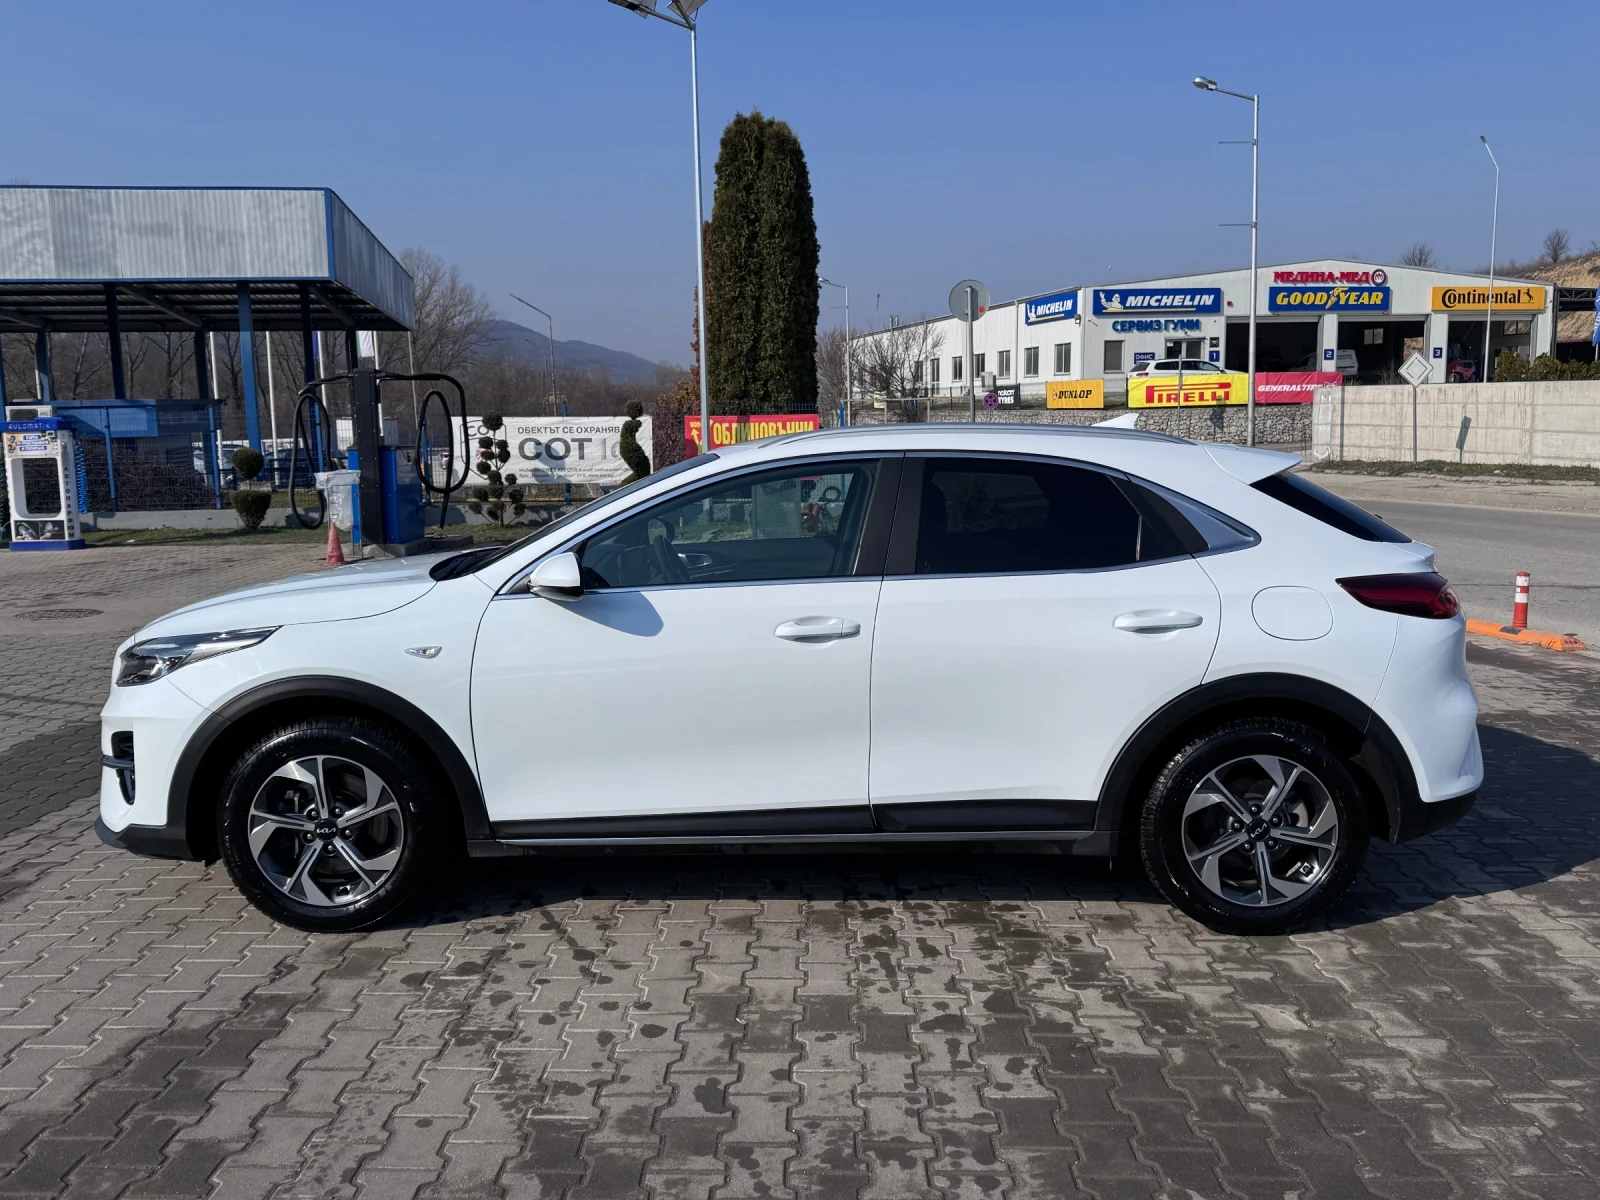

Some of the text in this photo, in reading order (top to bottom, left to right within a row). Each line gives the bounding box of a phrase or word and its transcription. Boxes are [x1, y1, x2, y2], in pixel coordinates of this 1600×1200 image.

[1125, 294, 1216, 306] MICHELIN
[1441, 288, 1521, 308] Continental
[1036, 299, 1073, 317] MICHELIN
[1112, 319, 1200, 332] СЕРВИЗ ГУМИ
[1434, 349, 1441, 357] 3
[1058, 389, 1092, 400] DUNLOP
[1145, 382, 1231, 404] PIRELLI
[517, 426, 620, 434] ОБЕКТЪТ СЕ ОХРАНЯВ
[518, 437, 593, 460] СОТ
[63, 466, 74, 538] АВТОПАРФЮМ
